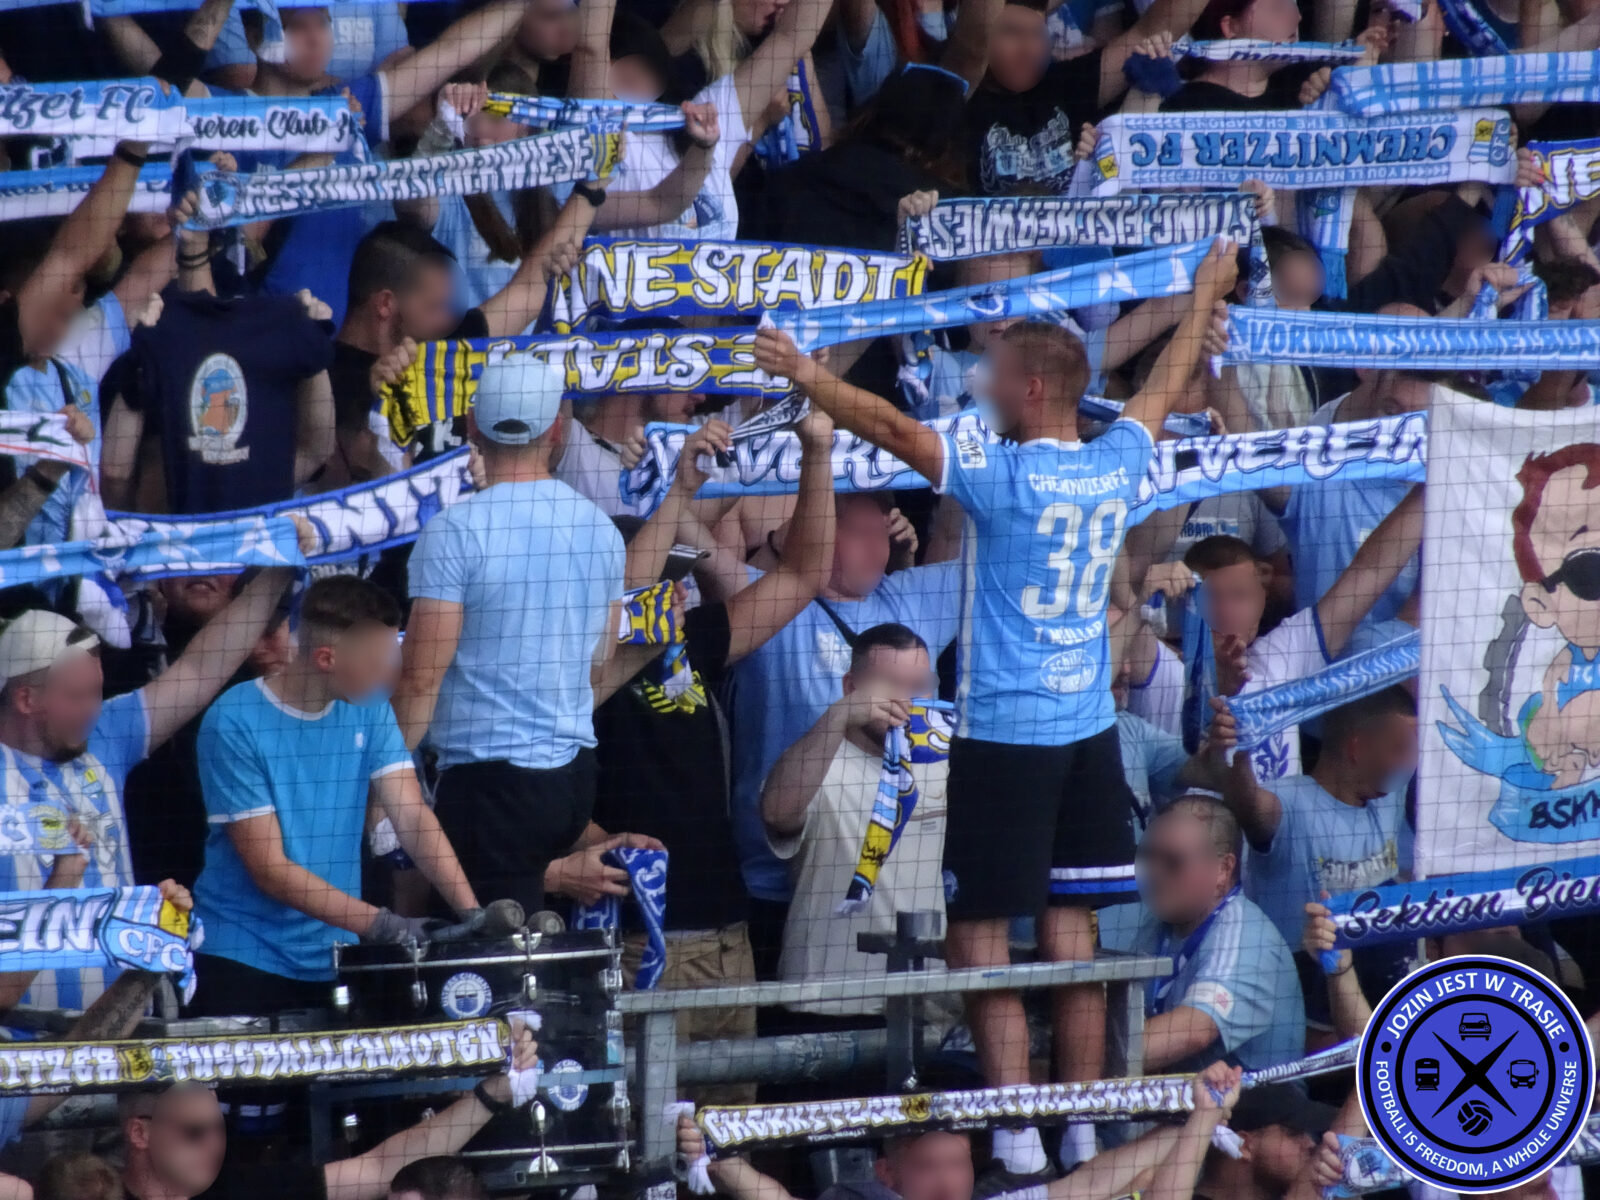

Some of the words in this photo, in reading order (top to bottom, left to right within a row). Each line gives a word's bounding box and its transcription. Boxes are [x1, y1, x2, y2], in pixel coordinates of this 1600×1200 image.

[97, 84, 154, 124] FC
[267, 110, 327, 140] Club
[1295, 117, 1326, 129] THE
[1129, 131, 1182, 167] FC
[1190, 124, 1458, 169] CHEMNITZER
[1295, 169, 1345, 183] NEVER
[689, 244, 917, 310] STADT
[486, 334, 715, 391] STA
[1196, 413, 1427, 480] VEREIN
[1021, 498, 1128, 619] 38
[1344, 888, 1502, 938] Sektion
[118, 927, 187, 971] CFC
